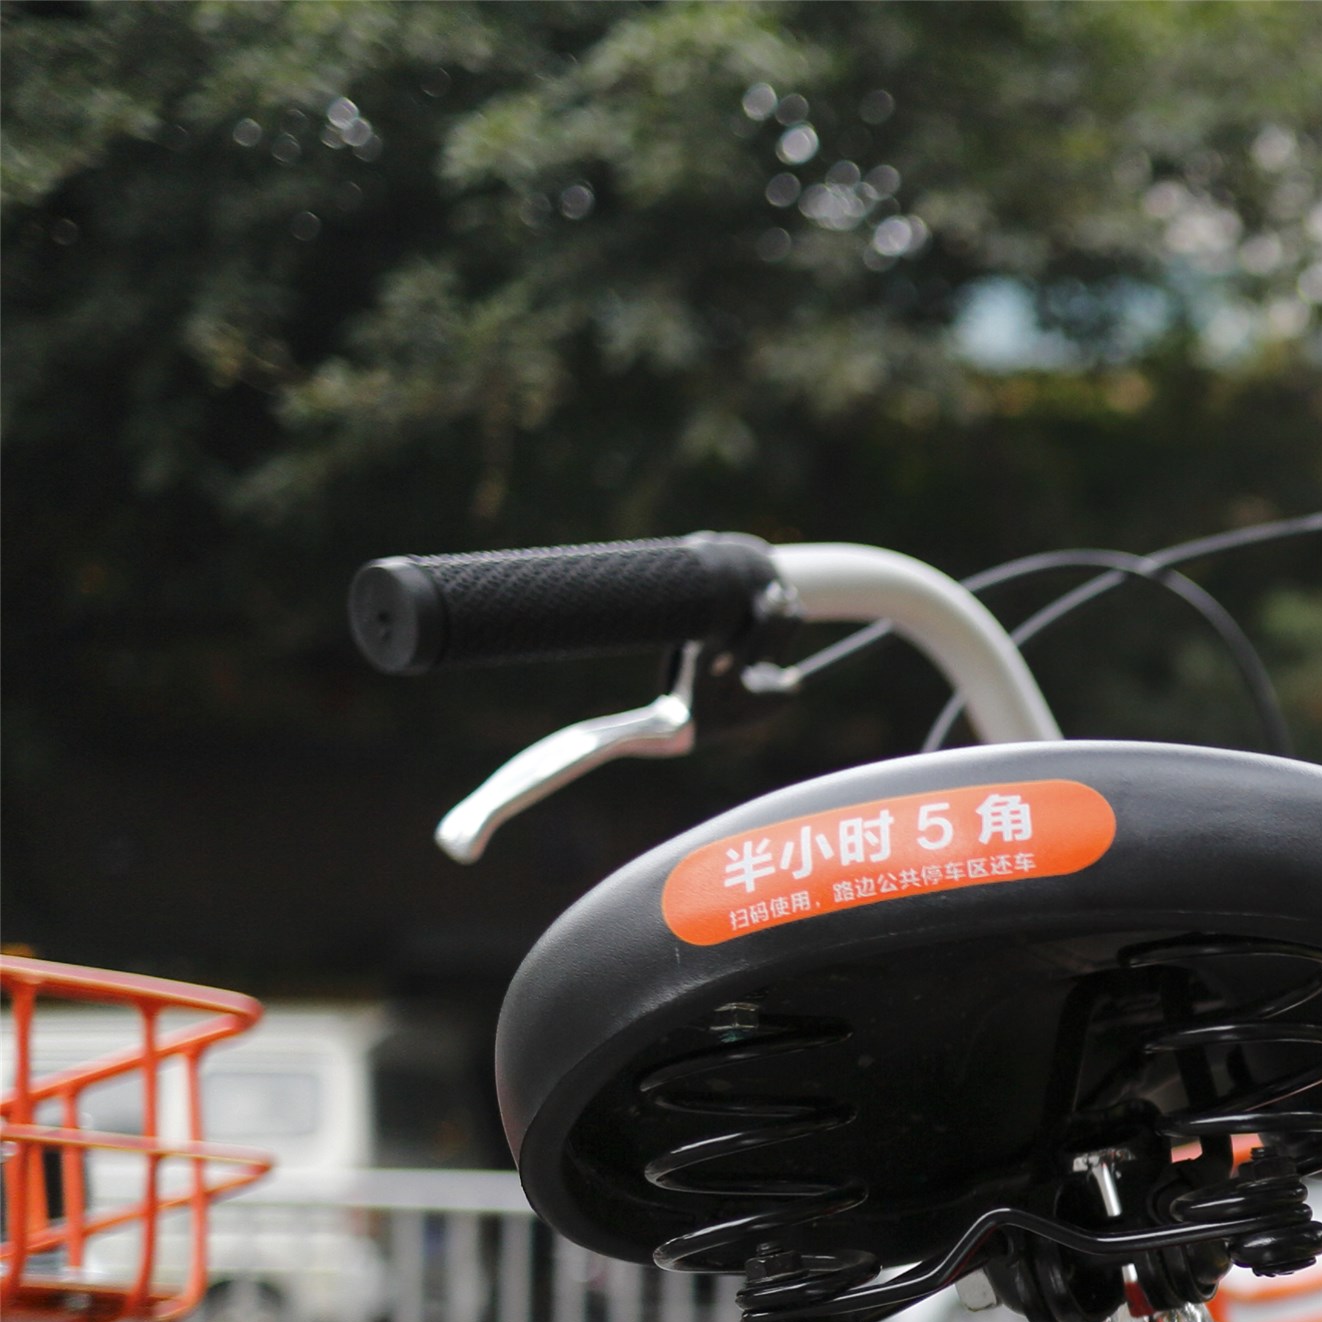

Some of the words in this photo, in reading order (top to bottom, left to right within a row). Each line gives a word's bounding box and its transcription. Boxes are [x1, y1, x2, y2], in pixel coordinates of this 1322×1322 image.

[722, 809, 894, 893] 半小时
[917, 802, 954, 851] 5
[977, 793, 1034, 845] 角
